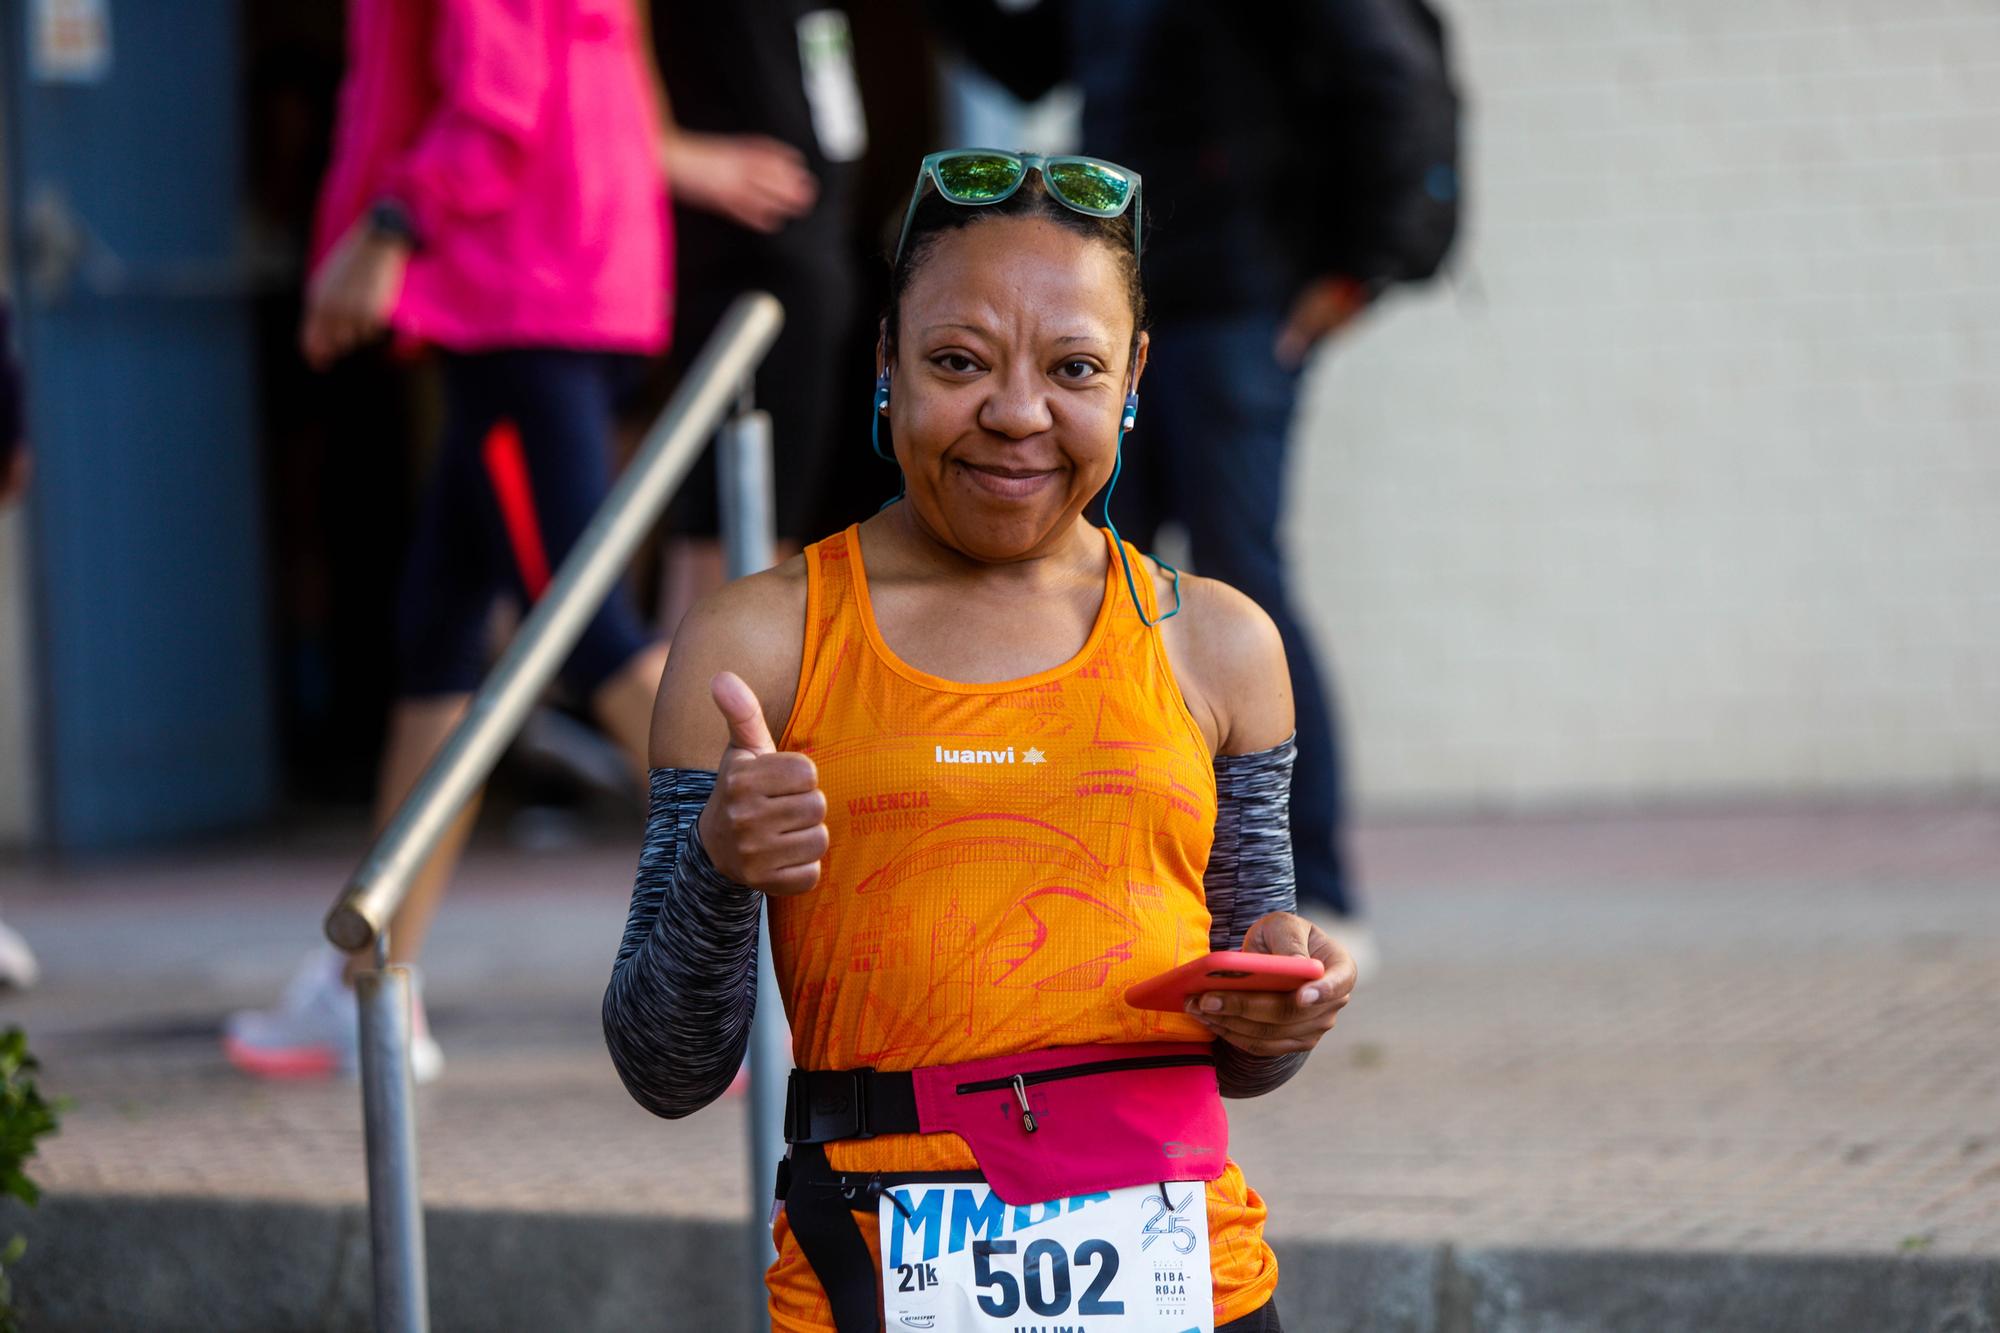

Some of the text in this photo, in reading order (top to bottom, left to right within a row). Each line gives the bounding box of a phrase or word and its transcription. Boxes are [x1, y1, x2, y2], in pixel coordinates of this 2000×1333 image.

[935, 745, 1015, 763] luanvi
[848, 790, 929, 816] VALENCIA
[849, 811, 929, 838] RUNNING
[890, 1189, 1111, 1269] MM
[897, 1263, 939, 1292] 21k
[972, 1238, 1124, 1319] 502
[1154, 1271, 1191, 1281] RIBA-
